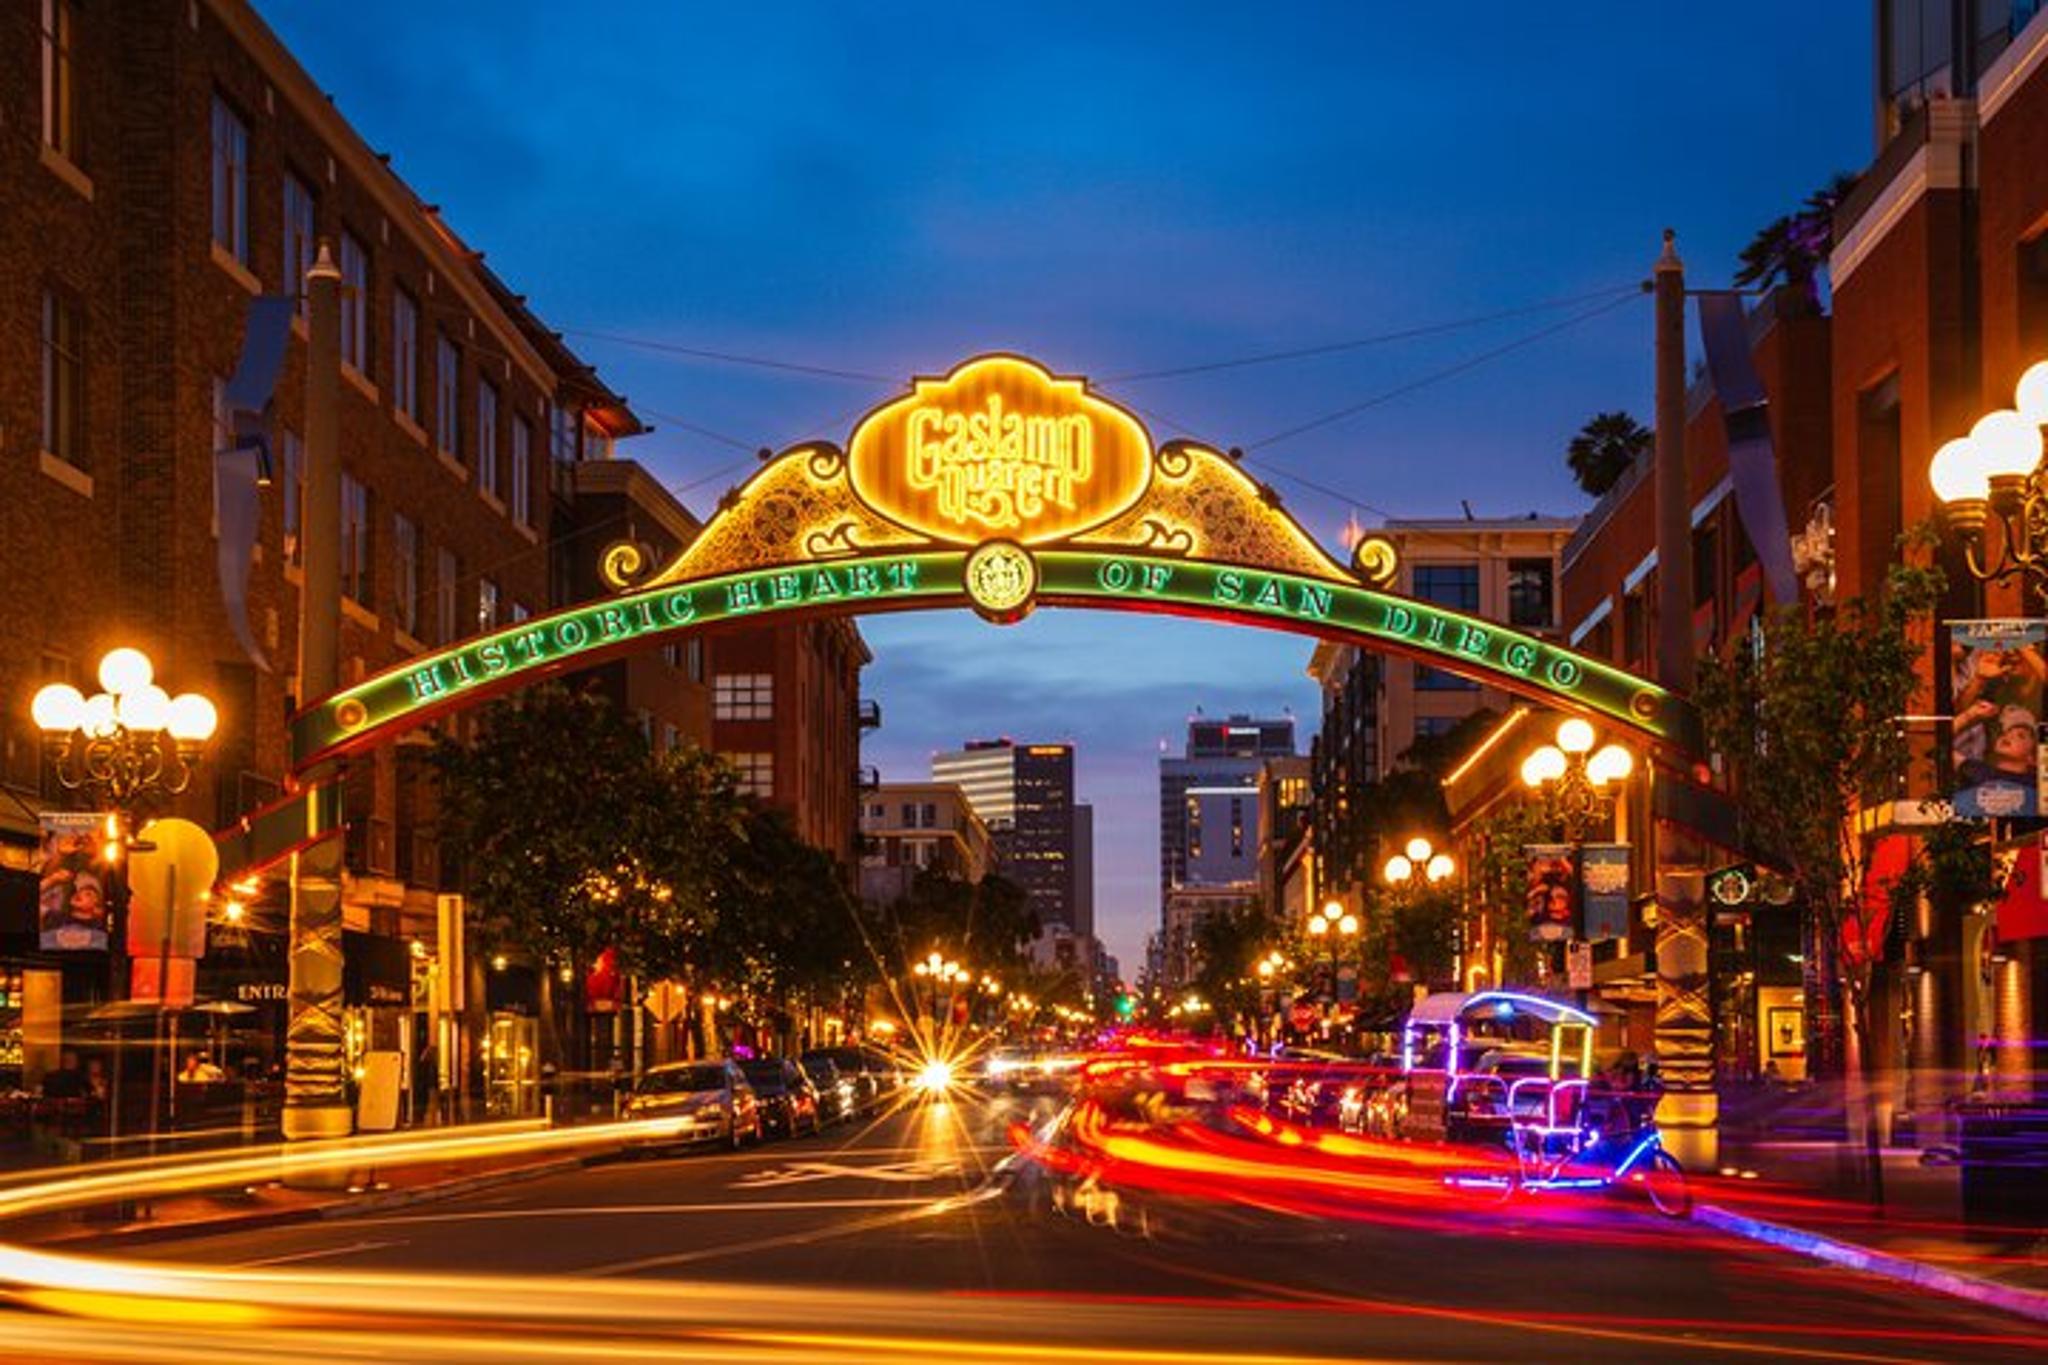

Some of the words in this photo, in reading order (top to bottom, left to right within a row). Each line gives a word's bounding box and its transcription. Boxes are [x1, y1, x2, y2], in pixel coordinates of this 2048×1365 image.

[907, 393, 1093, 489] Gaslamp
[937, 459, 1077, 528] Quarter
[409, 591, 695, 704] HISTORIC
[727, 562, 917, 613] HEART
[1099, 560, 1173, 593] OF
[1214, 571, 1334, 618] SAN
[1385, 605, 1583, 689] DIEGO
